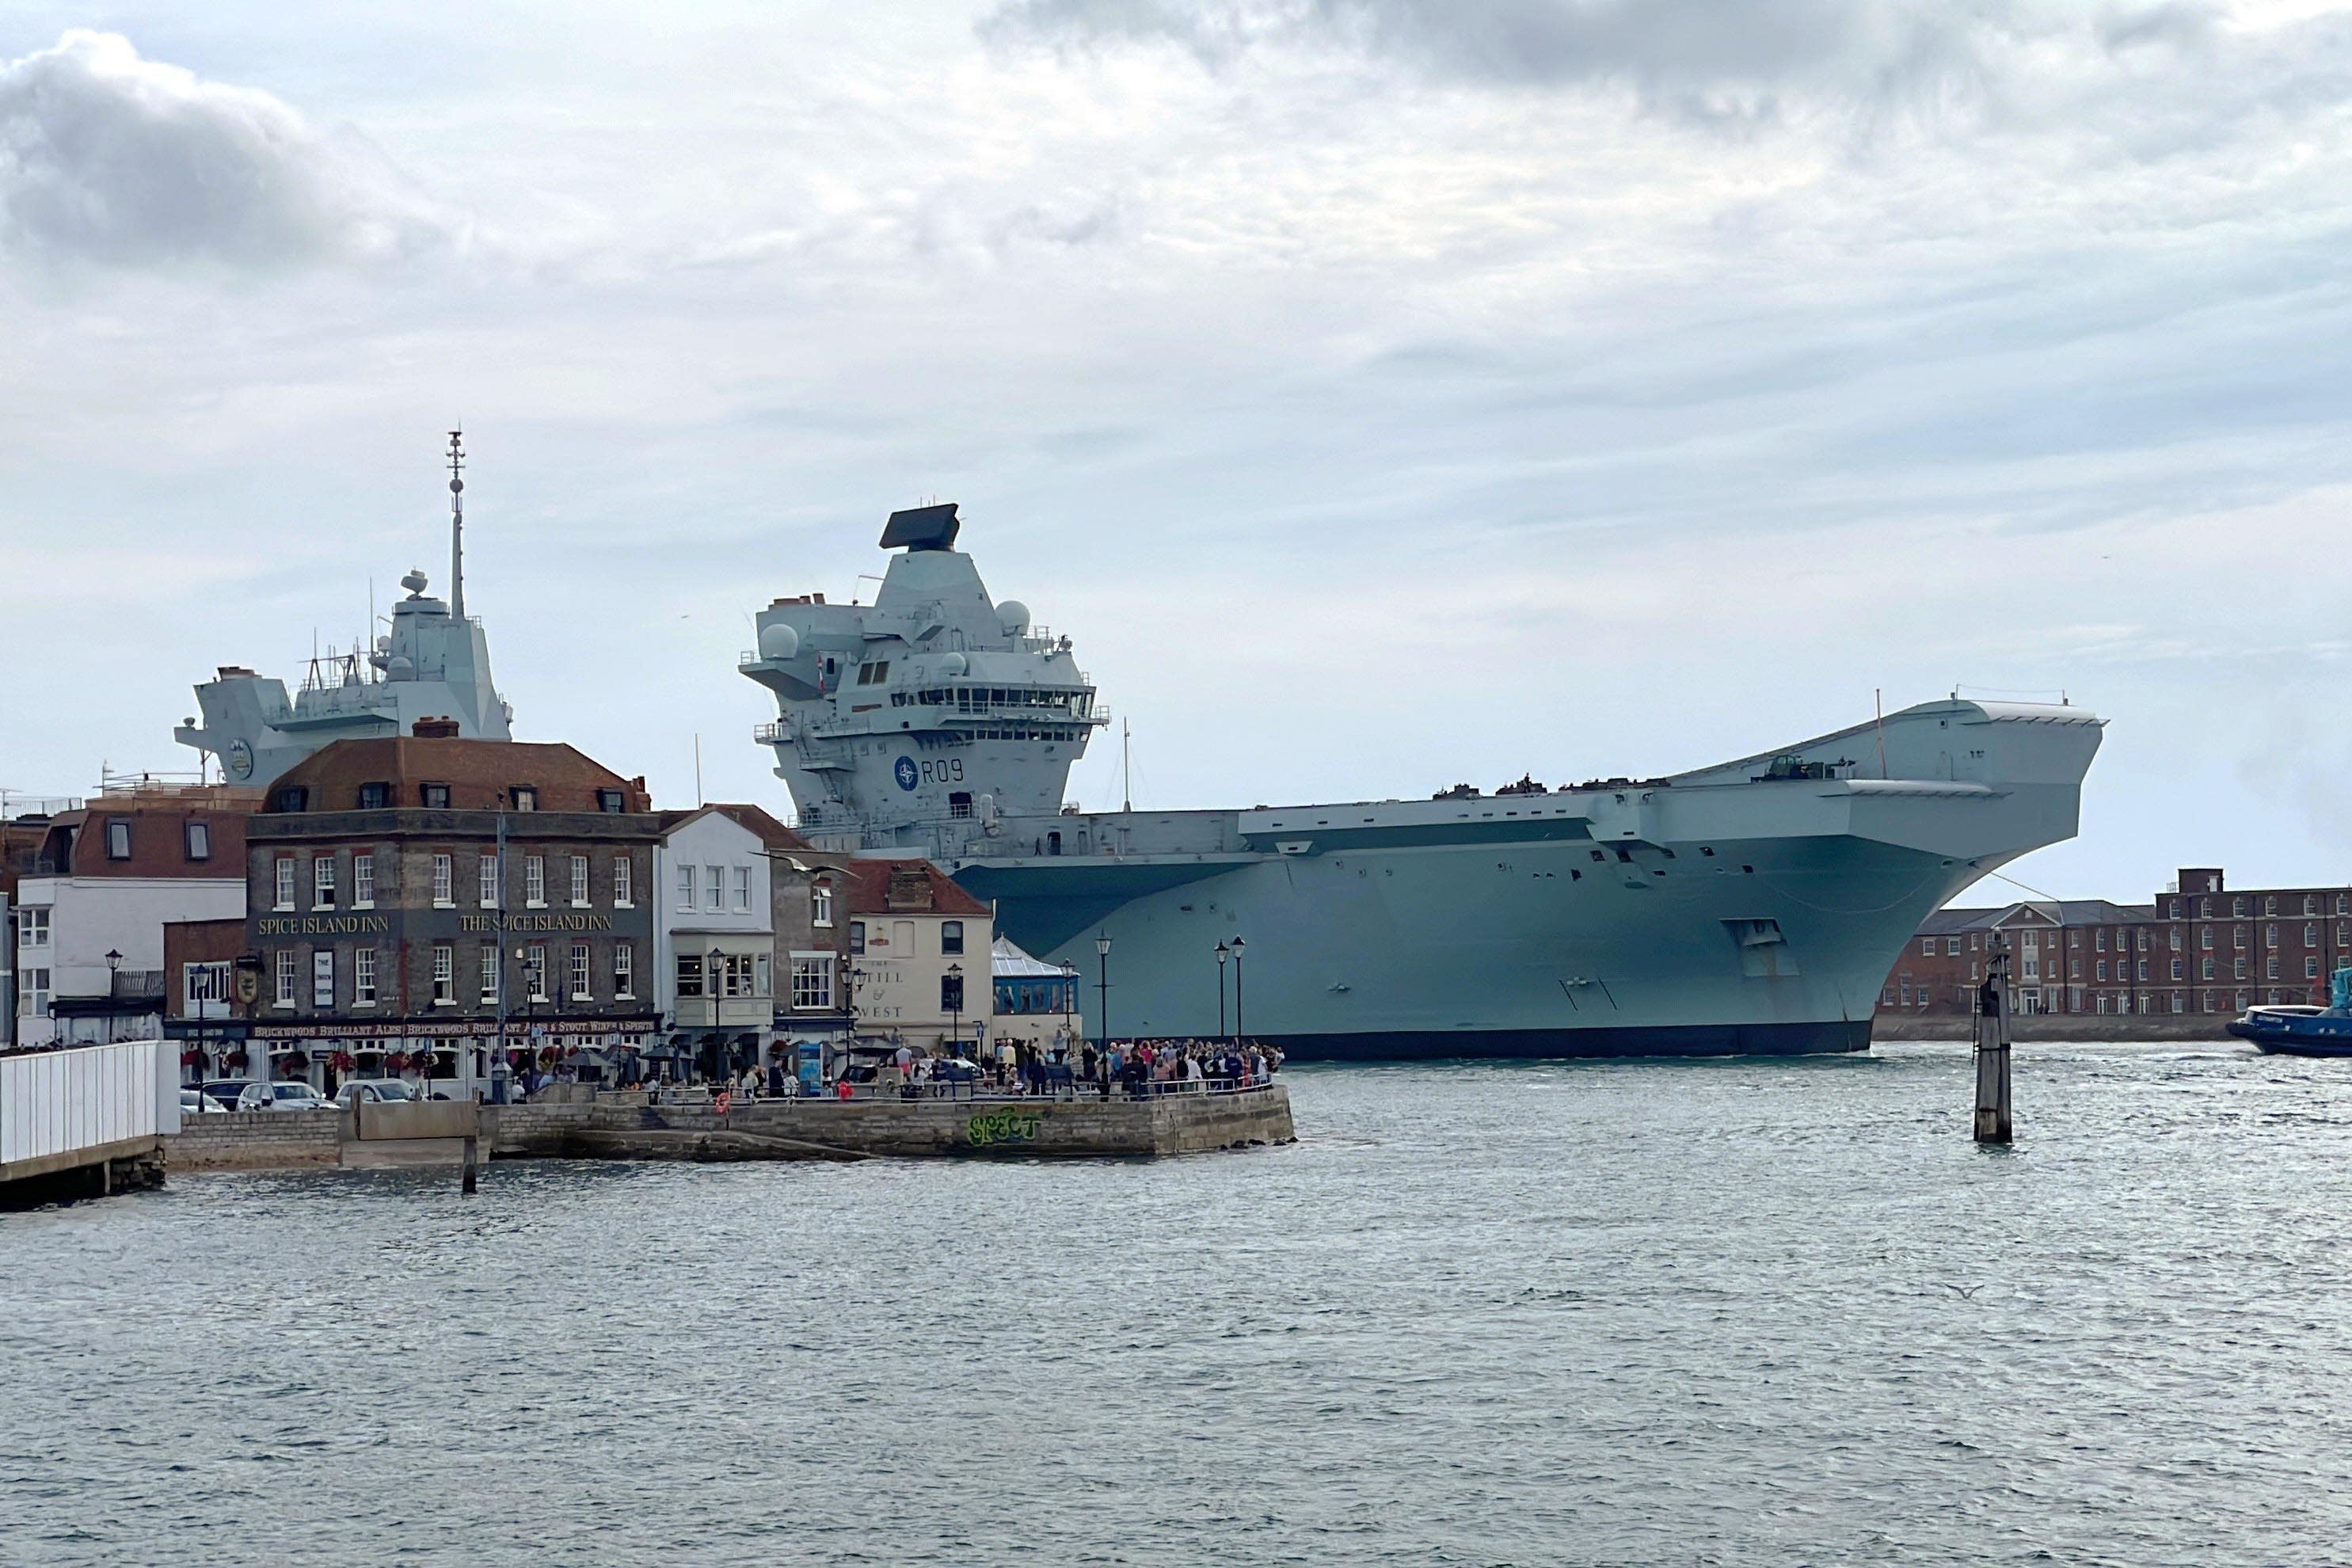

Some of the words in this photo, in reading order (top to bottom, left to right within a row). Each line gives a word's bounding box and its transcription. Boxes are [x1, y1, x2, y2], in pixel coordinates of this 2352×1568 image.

[258, 919, 298, 935] SPICE
[302, 917, 357, 934] ISLAND
[361, 915, 389, 933] INN
[461, 915, 490, 931] THE
[534, 915, 585, 931] ISLAND
[588, 915, 612, 931] INN
[866, 972, 904, 983] TILL
[858, 1007, 902, 1018] WEST
